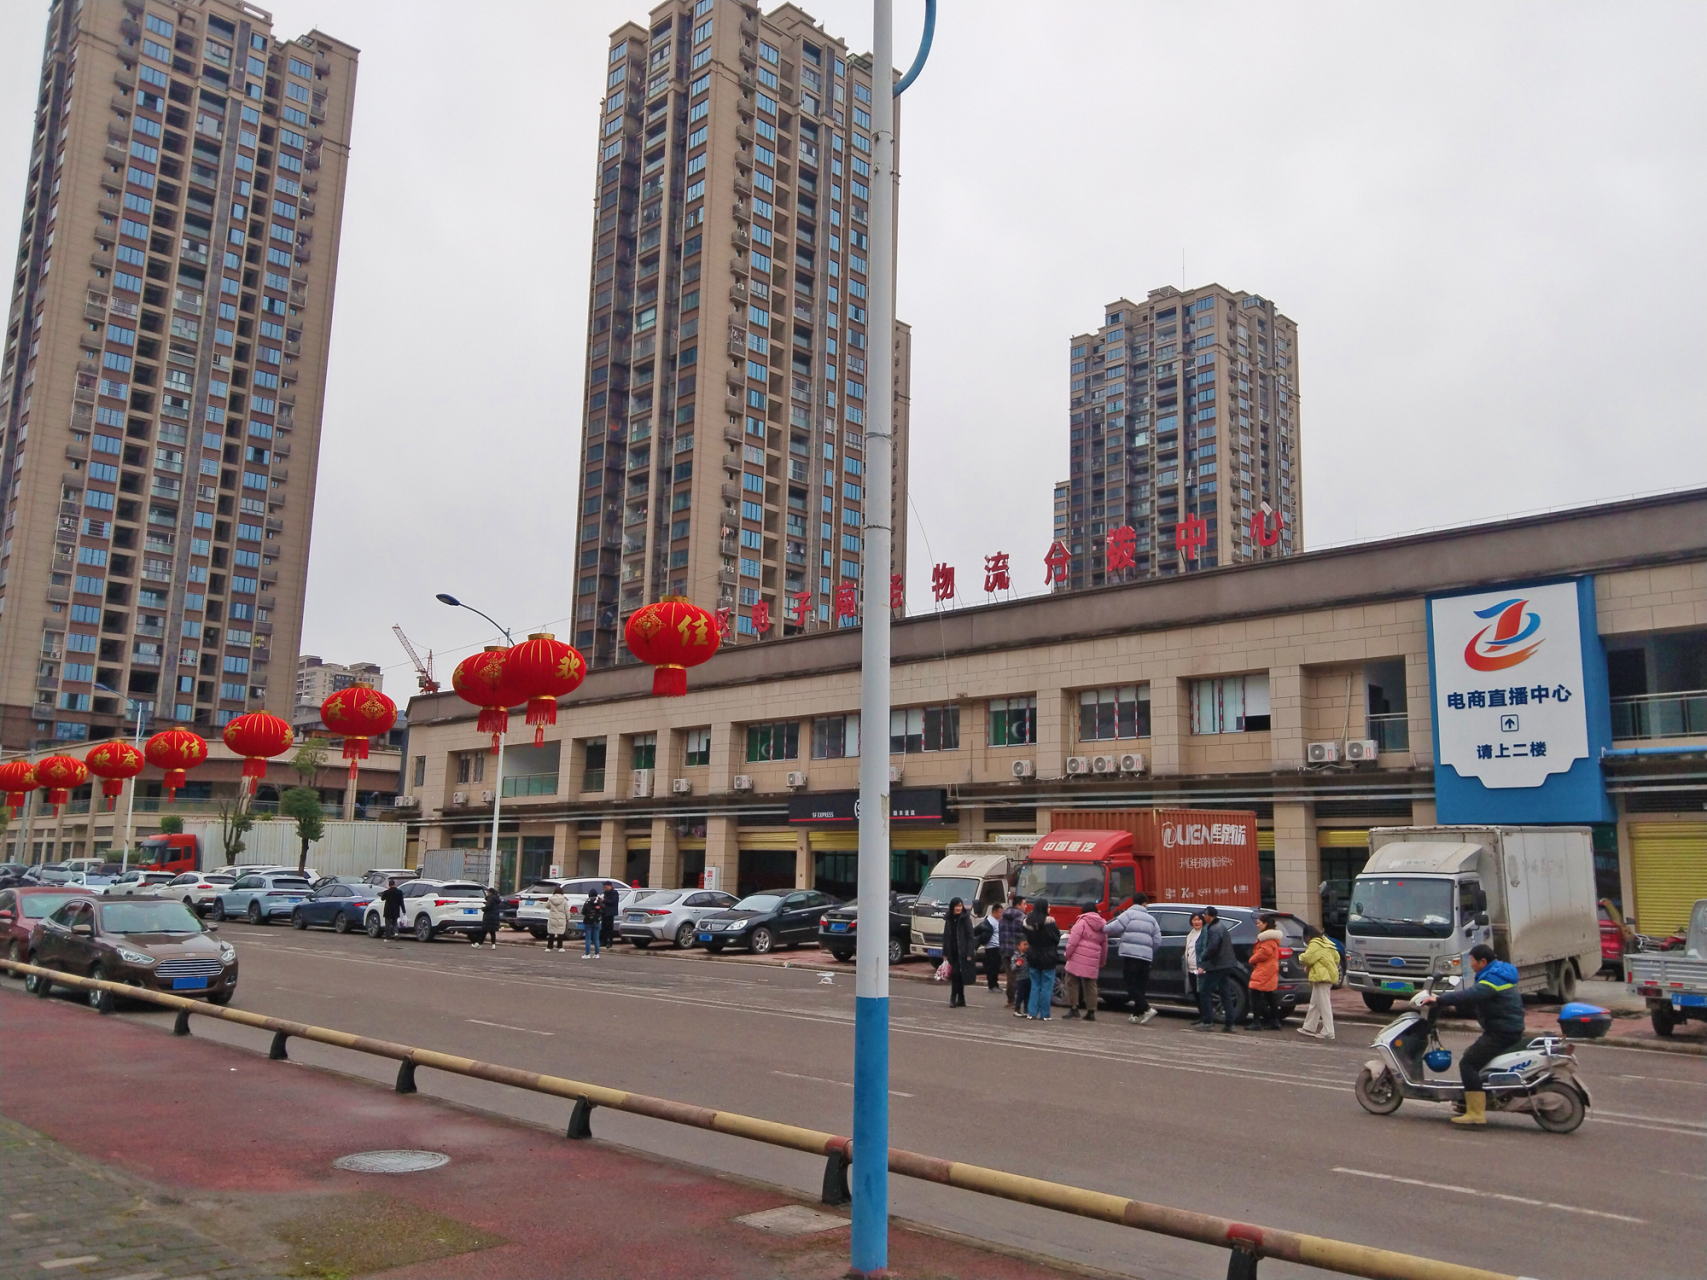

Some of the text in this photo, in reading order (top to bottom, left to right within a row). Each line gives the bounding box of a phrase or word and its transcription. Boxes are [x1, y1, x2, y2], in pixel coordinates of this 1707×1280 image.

[677, 612, 709, 647] 佳
[1447, 684, 1572, 710] 电商直播中心
[1477, 741, 1547, 760] 请上二楼
